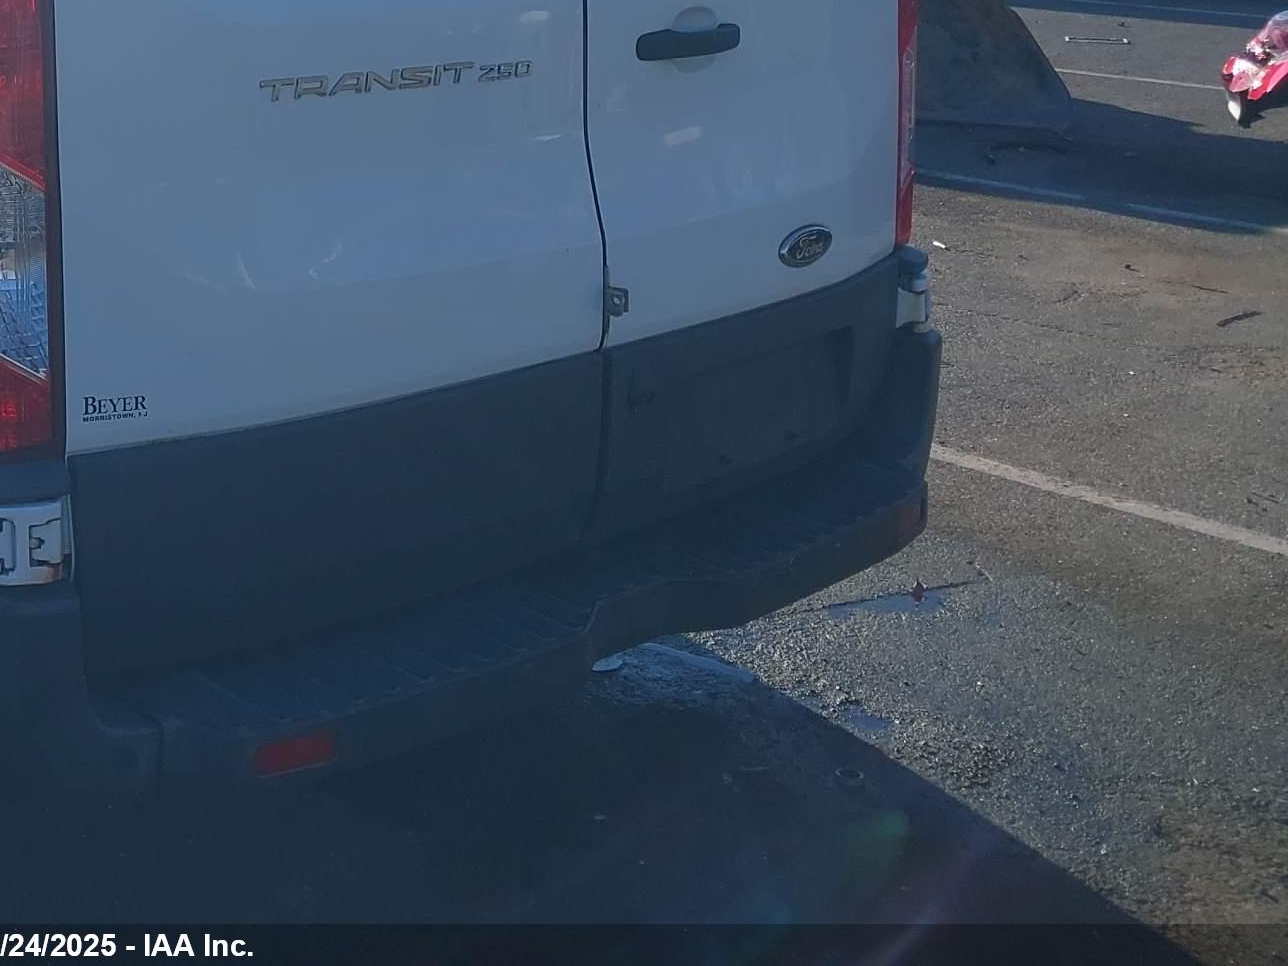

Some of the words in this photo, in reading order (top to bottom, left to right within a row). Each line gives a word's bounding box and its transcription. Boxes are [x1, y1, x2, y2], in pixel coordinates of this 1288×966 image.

[259, 61, 475, 102] TRANSIT
[478, 60, 534, 82] 250
[82, 395, 148, 415] BEYER
